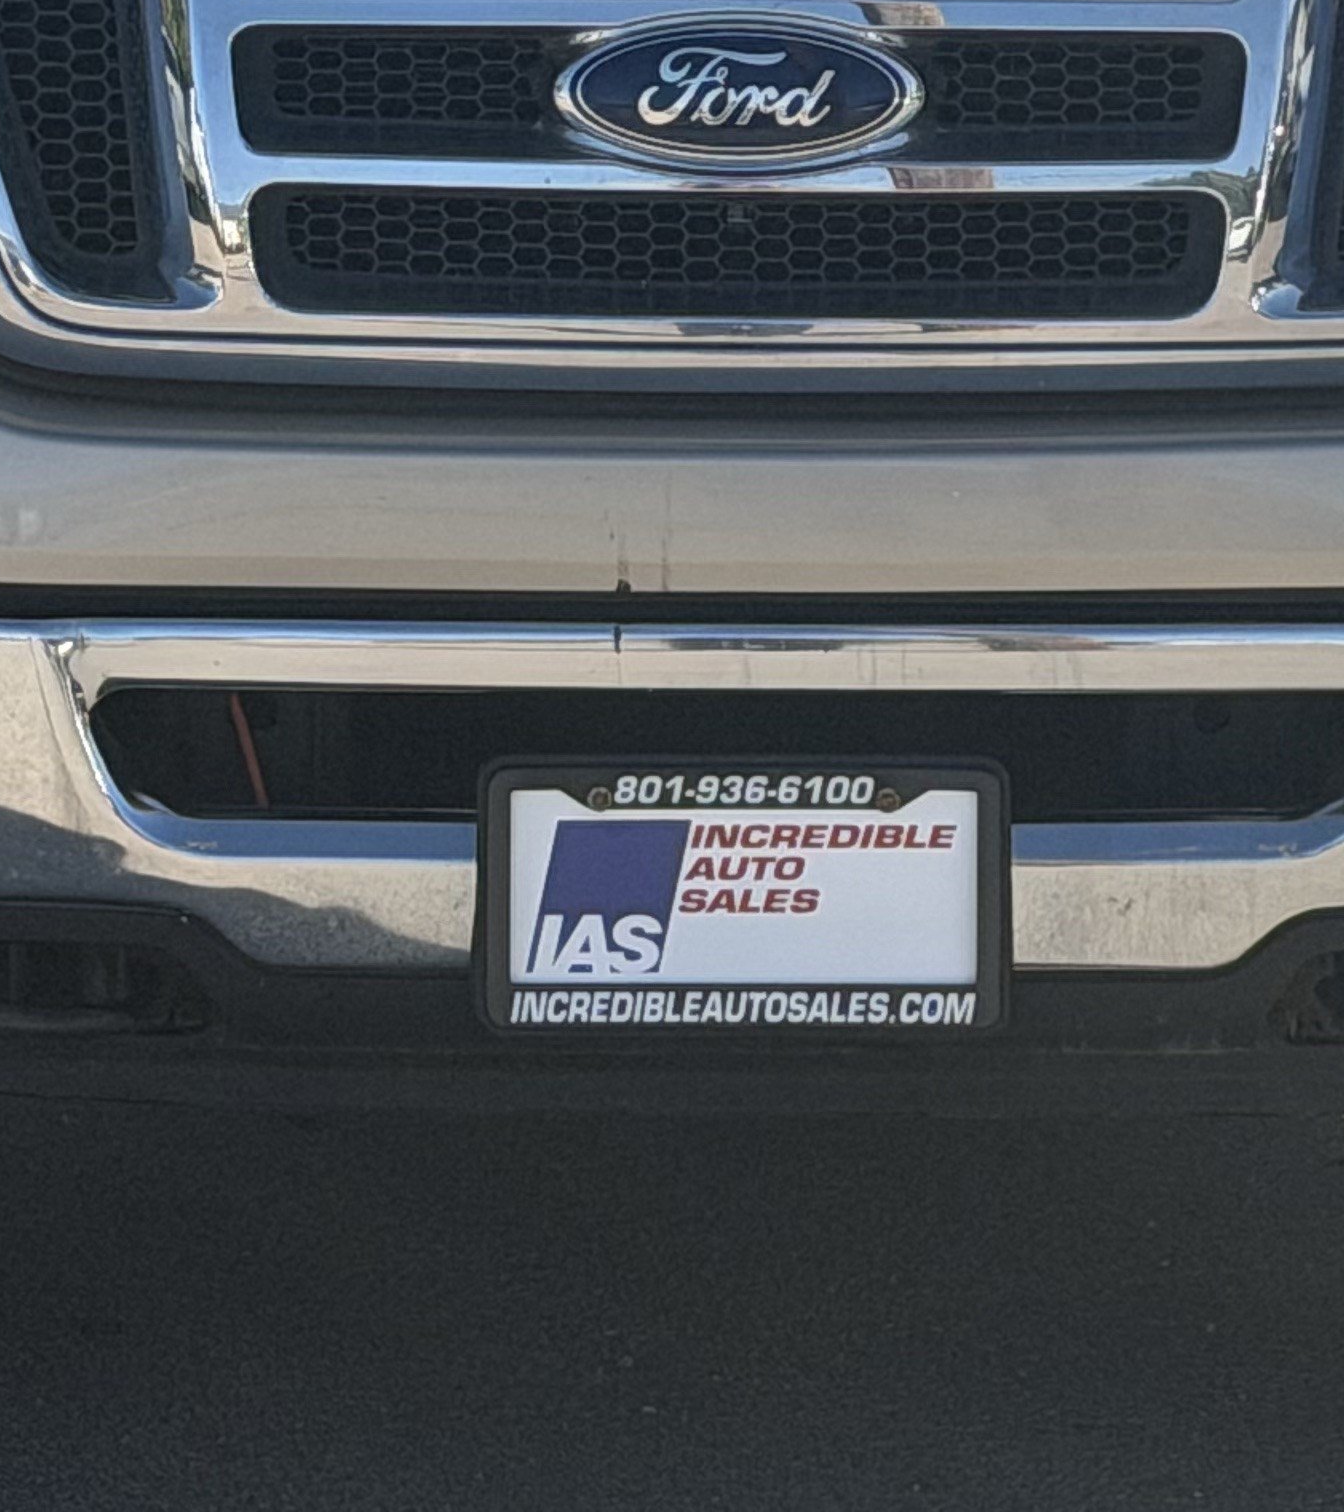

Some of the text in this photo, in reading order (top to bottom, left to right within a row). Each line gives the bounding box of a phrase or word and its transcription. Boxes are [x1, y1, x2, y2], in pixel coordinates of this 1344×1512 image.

[637, 46, 836, 127] Ford
[612, 774, 875, 805] 801-936-6100
[690, 823, 957, 850] INCREDIBLE
[684, 856, 806, 881] AUTO
[677, 888, 820, 914] SALES
[531, 913, 663, 974] IAS
[510, 991, 976, 1025] INCREDIBLEAUTOSALES.COM
